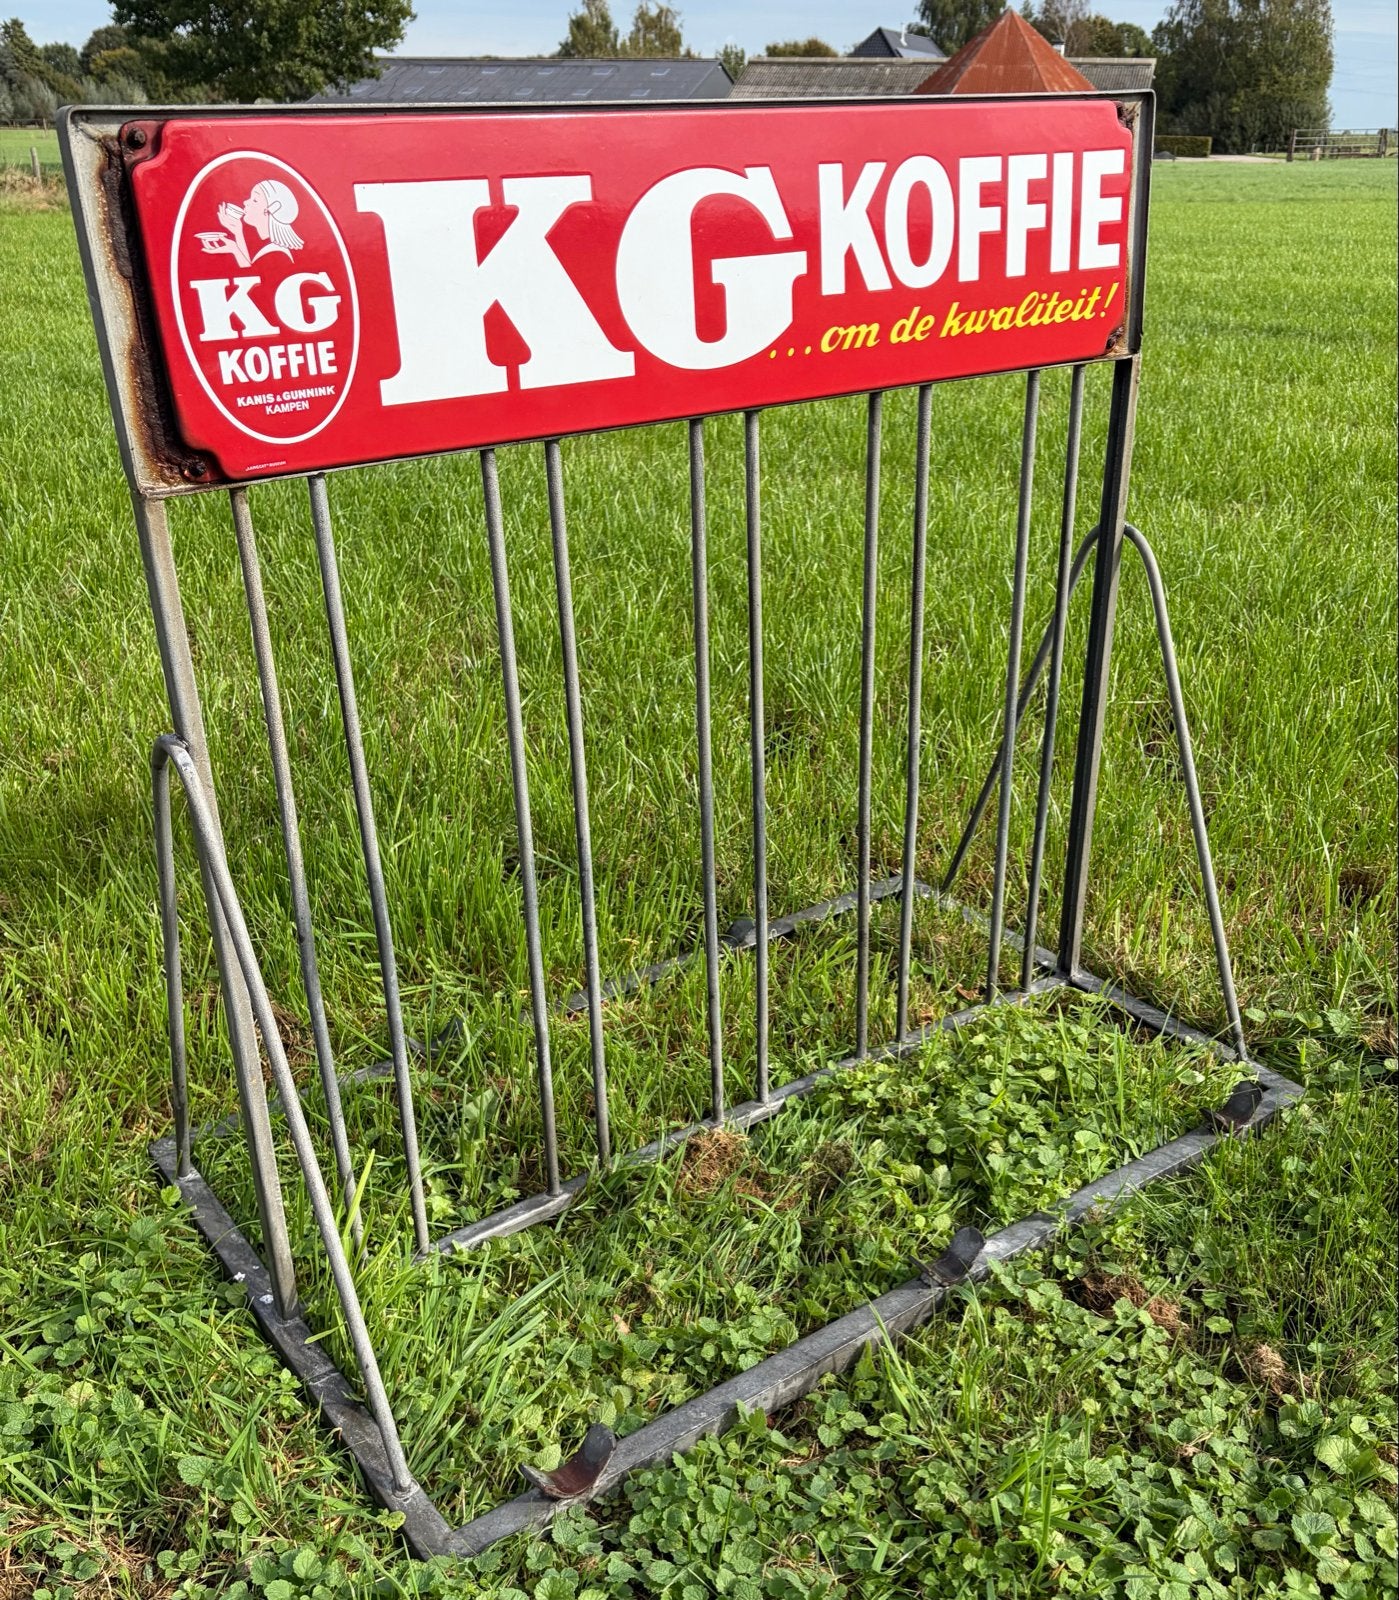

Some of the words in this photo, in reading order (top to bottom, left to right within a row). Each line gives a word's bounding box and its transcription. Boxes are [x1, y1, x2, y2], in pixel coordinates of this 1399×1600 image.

[353, 166, 808, 407] KG
[817, 148, 1126, 296] KOFFIE
[189, 271, 342, 342] KG
[889, 306, 935, 344] de
[939, 282, 1120, 339] kwaliteit!
[218, 340, 338, 385] KOFFIE
[236, 393, 275, 407] KANIS
[276, 394, 283, 402] &
[282, 385, 335, 401] GUNNINK
[265, 400, 310, 415] KAMPEN
